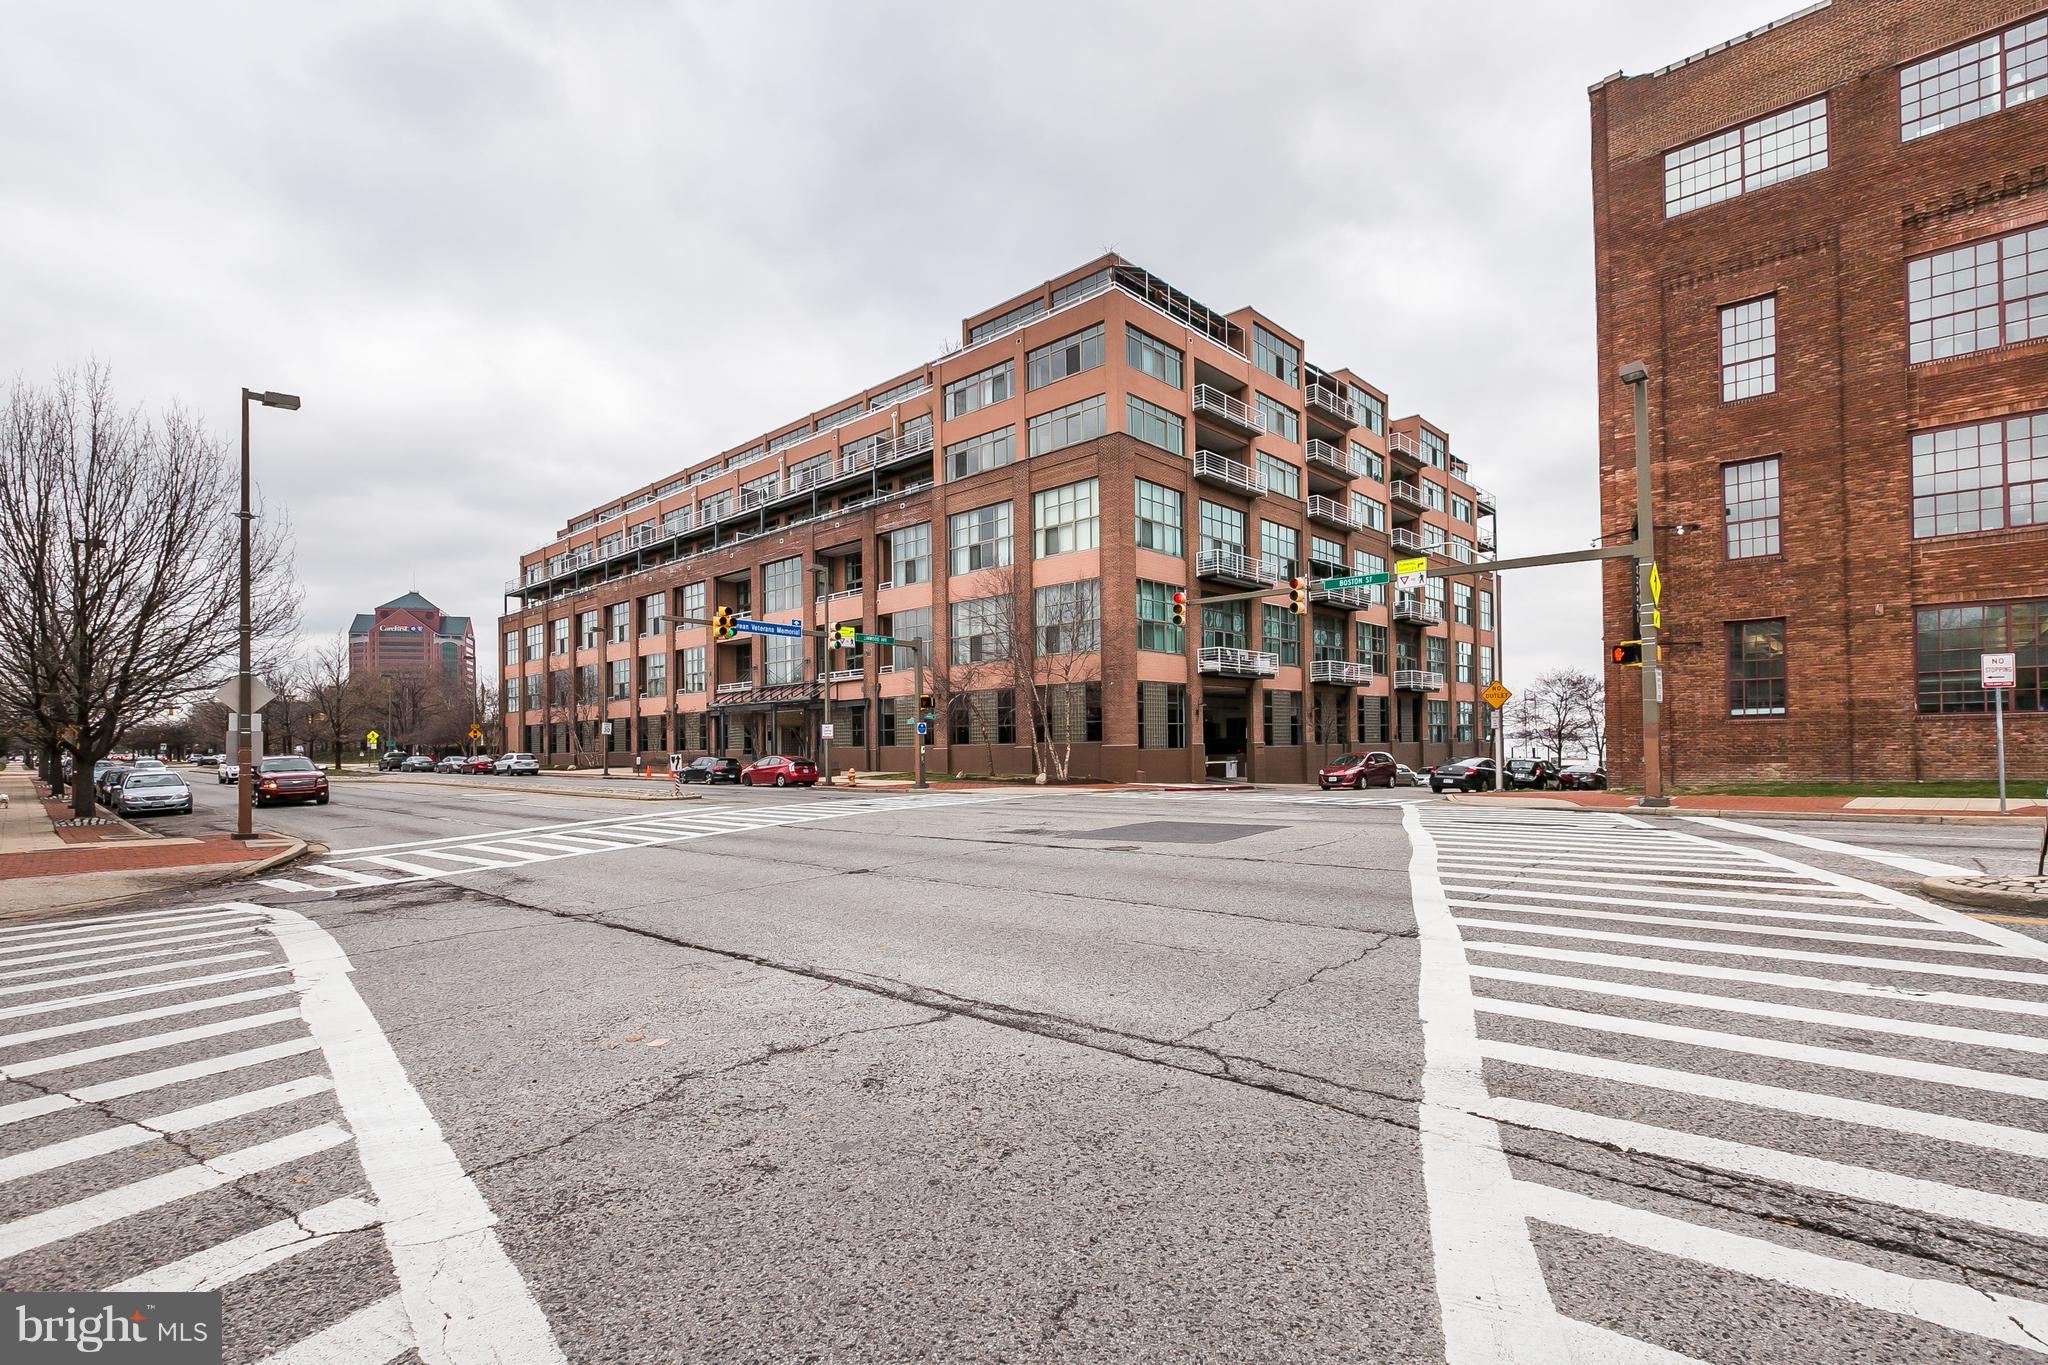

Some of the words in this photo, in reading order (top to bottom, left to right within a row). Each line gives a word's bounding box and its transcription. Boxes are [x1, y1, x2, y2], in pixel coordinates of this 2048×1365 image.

[1339, 578, 1362, 587] BOSTON
[751, 623, 775, 633] Veterans
[777, 626, 801, 636] Memorial
